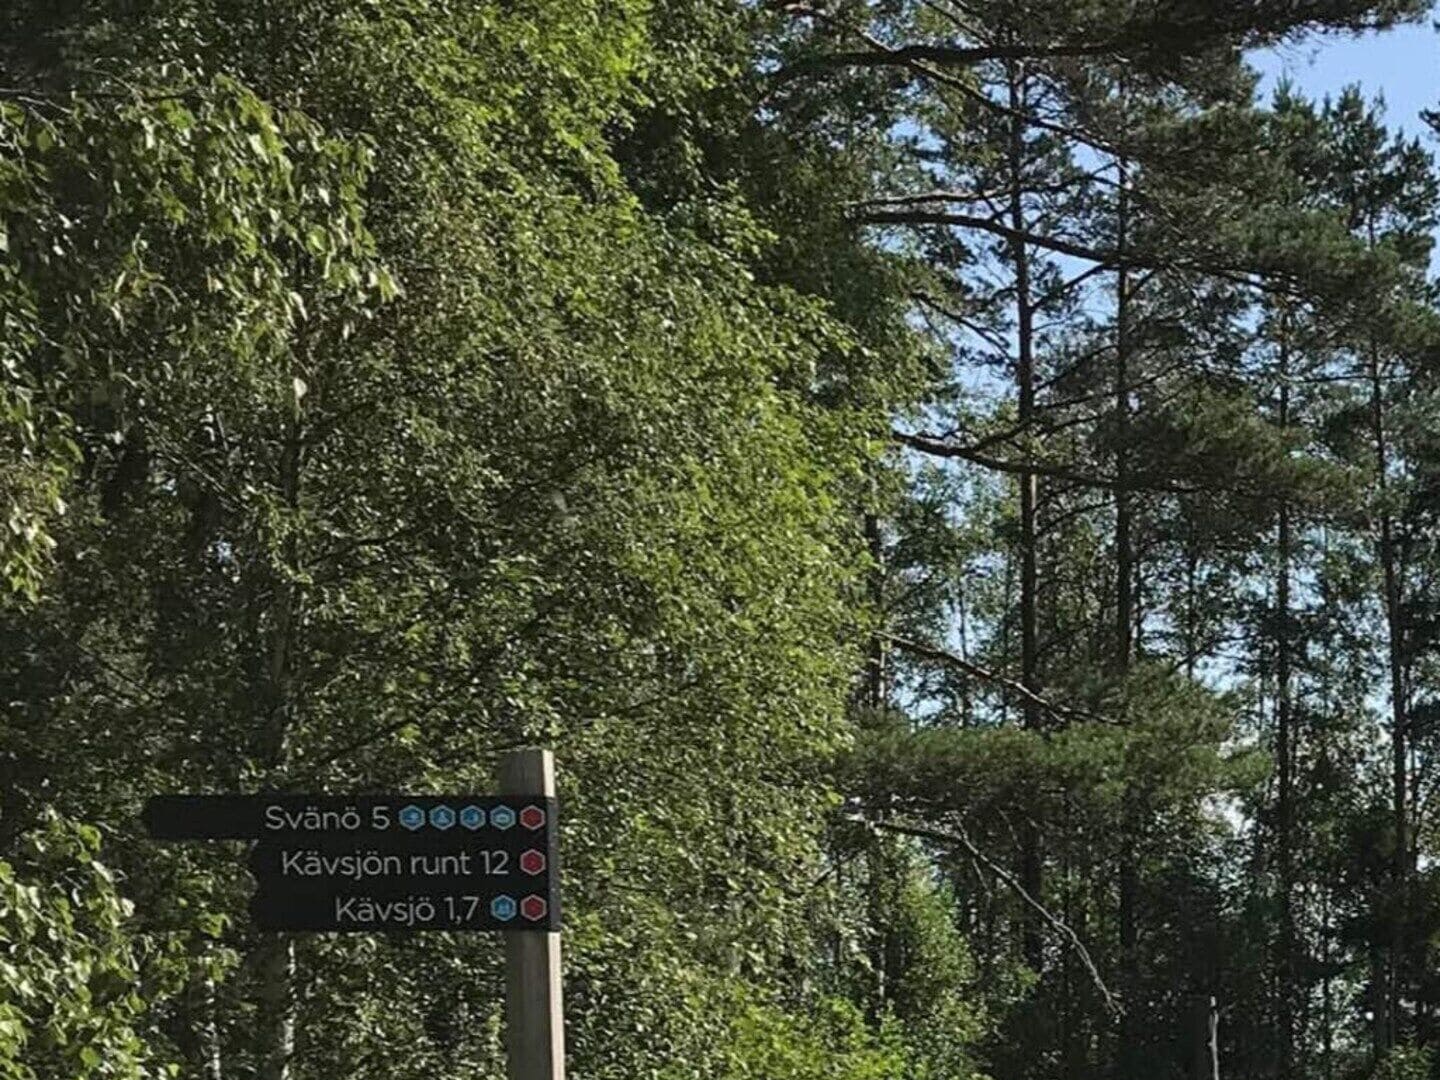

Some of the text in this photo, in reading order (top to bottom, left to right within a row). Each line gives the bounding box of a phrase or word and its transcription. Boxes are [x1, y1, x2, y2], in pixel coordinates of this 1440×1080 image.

[264, 805, 391, 830] Svänö 5
[281, 850, 510, 881] Kävsjön runt 12
[335, 896, 480, 926] Kävsjö 1,7
